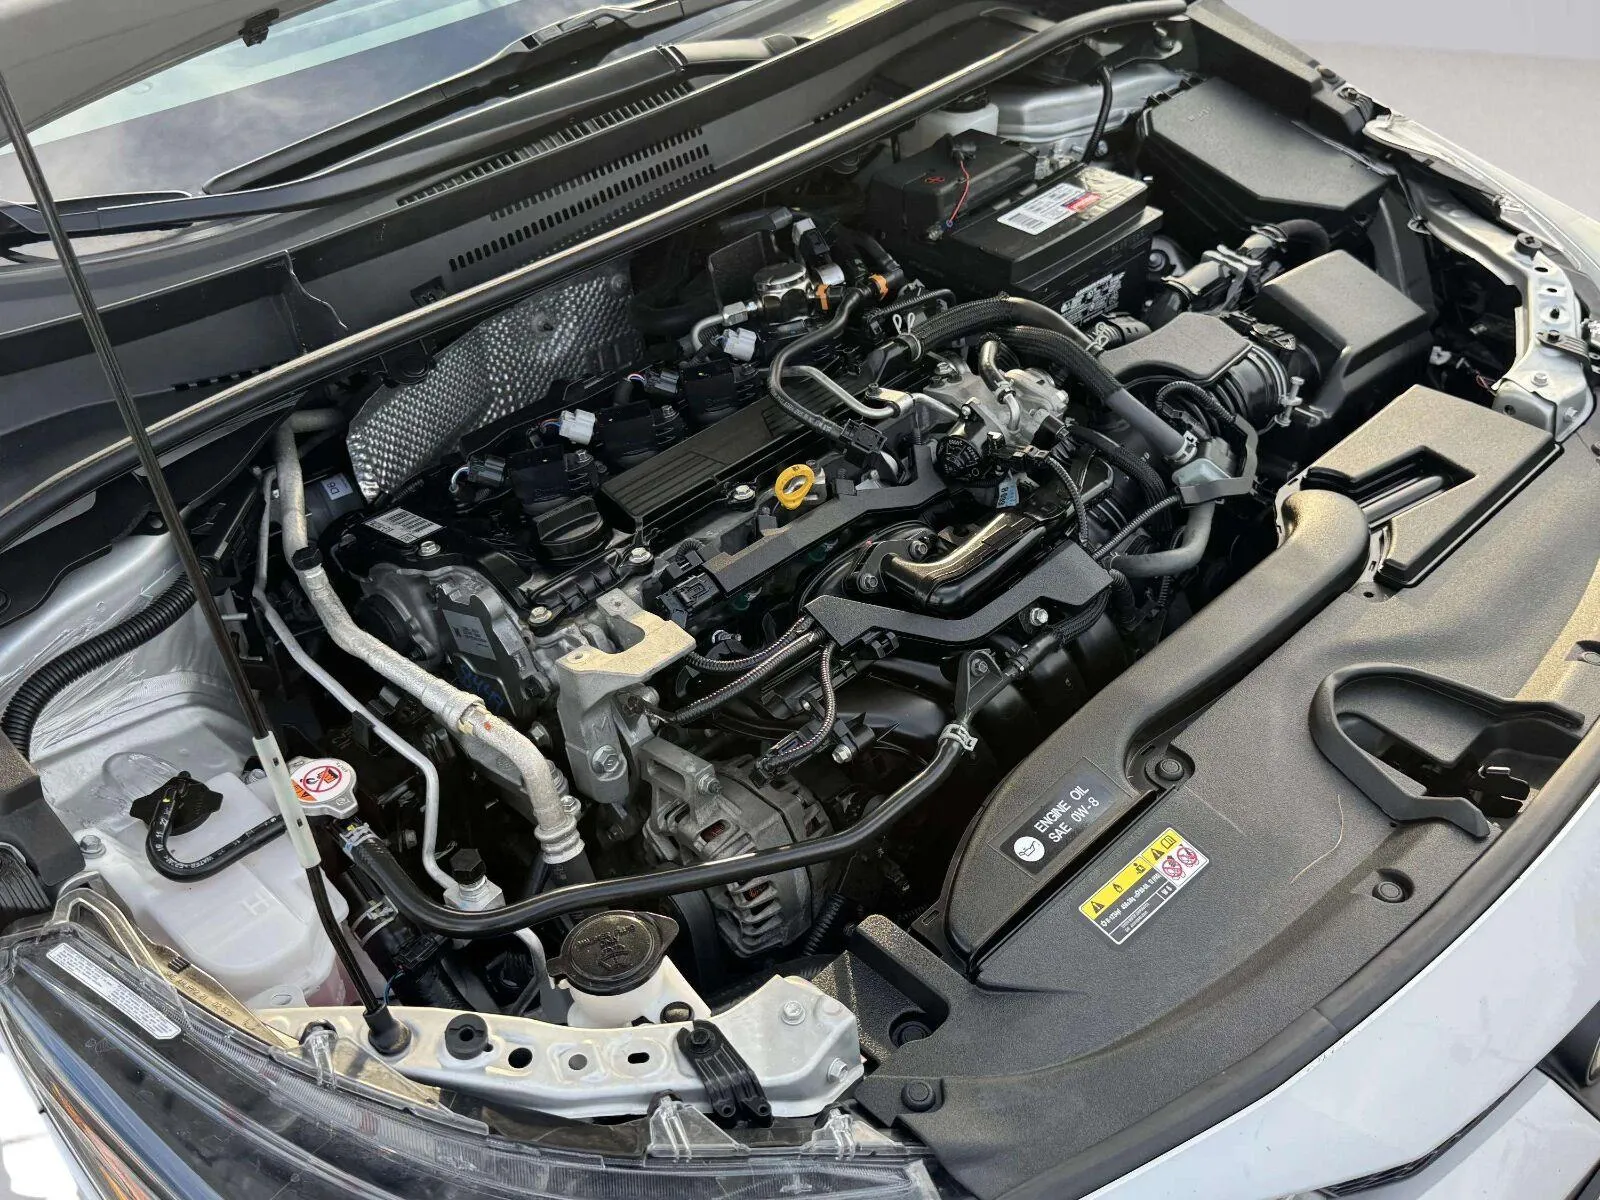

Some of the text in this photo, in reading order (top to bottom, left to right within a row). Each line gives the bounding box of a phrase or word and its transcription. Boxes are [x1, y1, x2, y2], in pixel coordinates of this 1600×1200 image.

[1034, 785, 1090, 833] ENGINE OIL
[1048, 796, 1100, 843] SAE 0W-8
